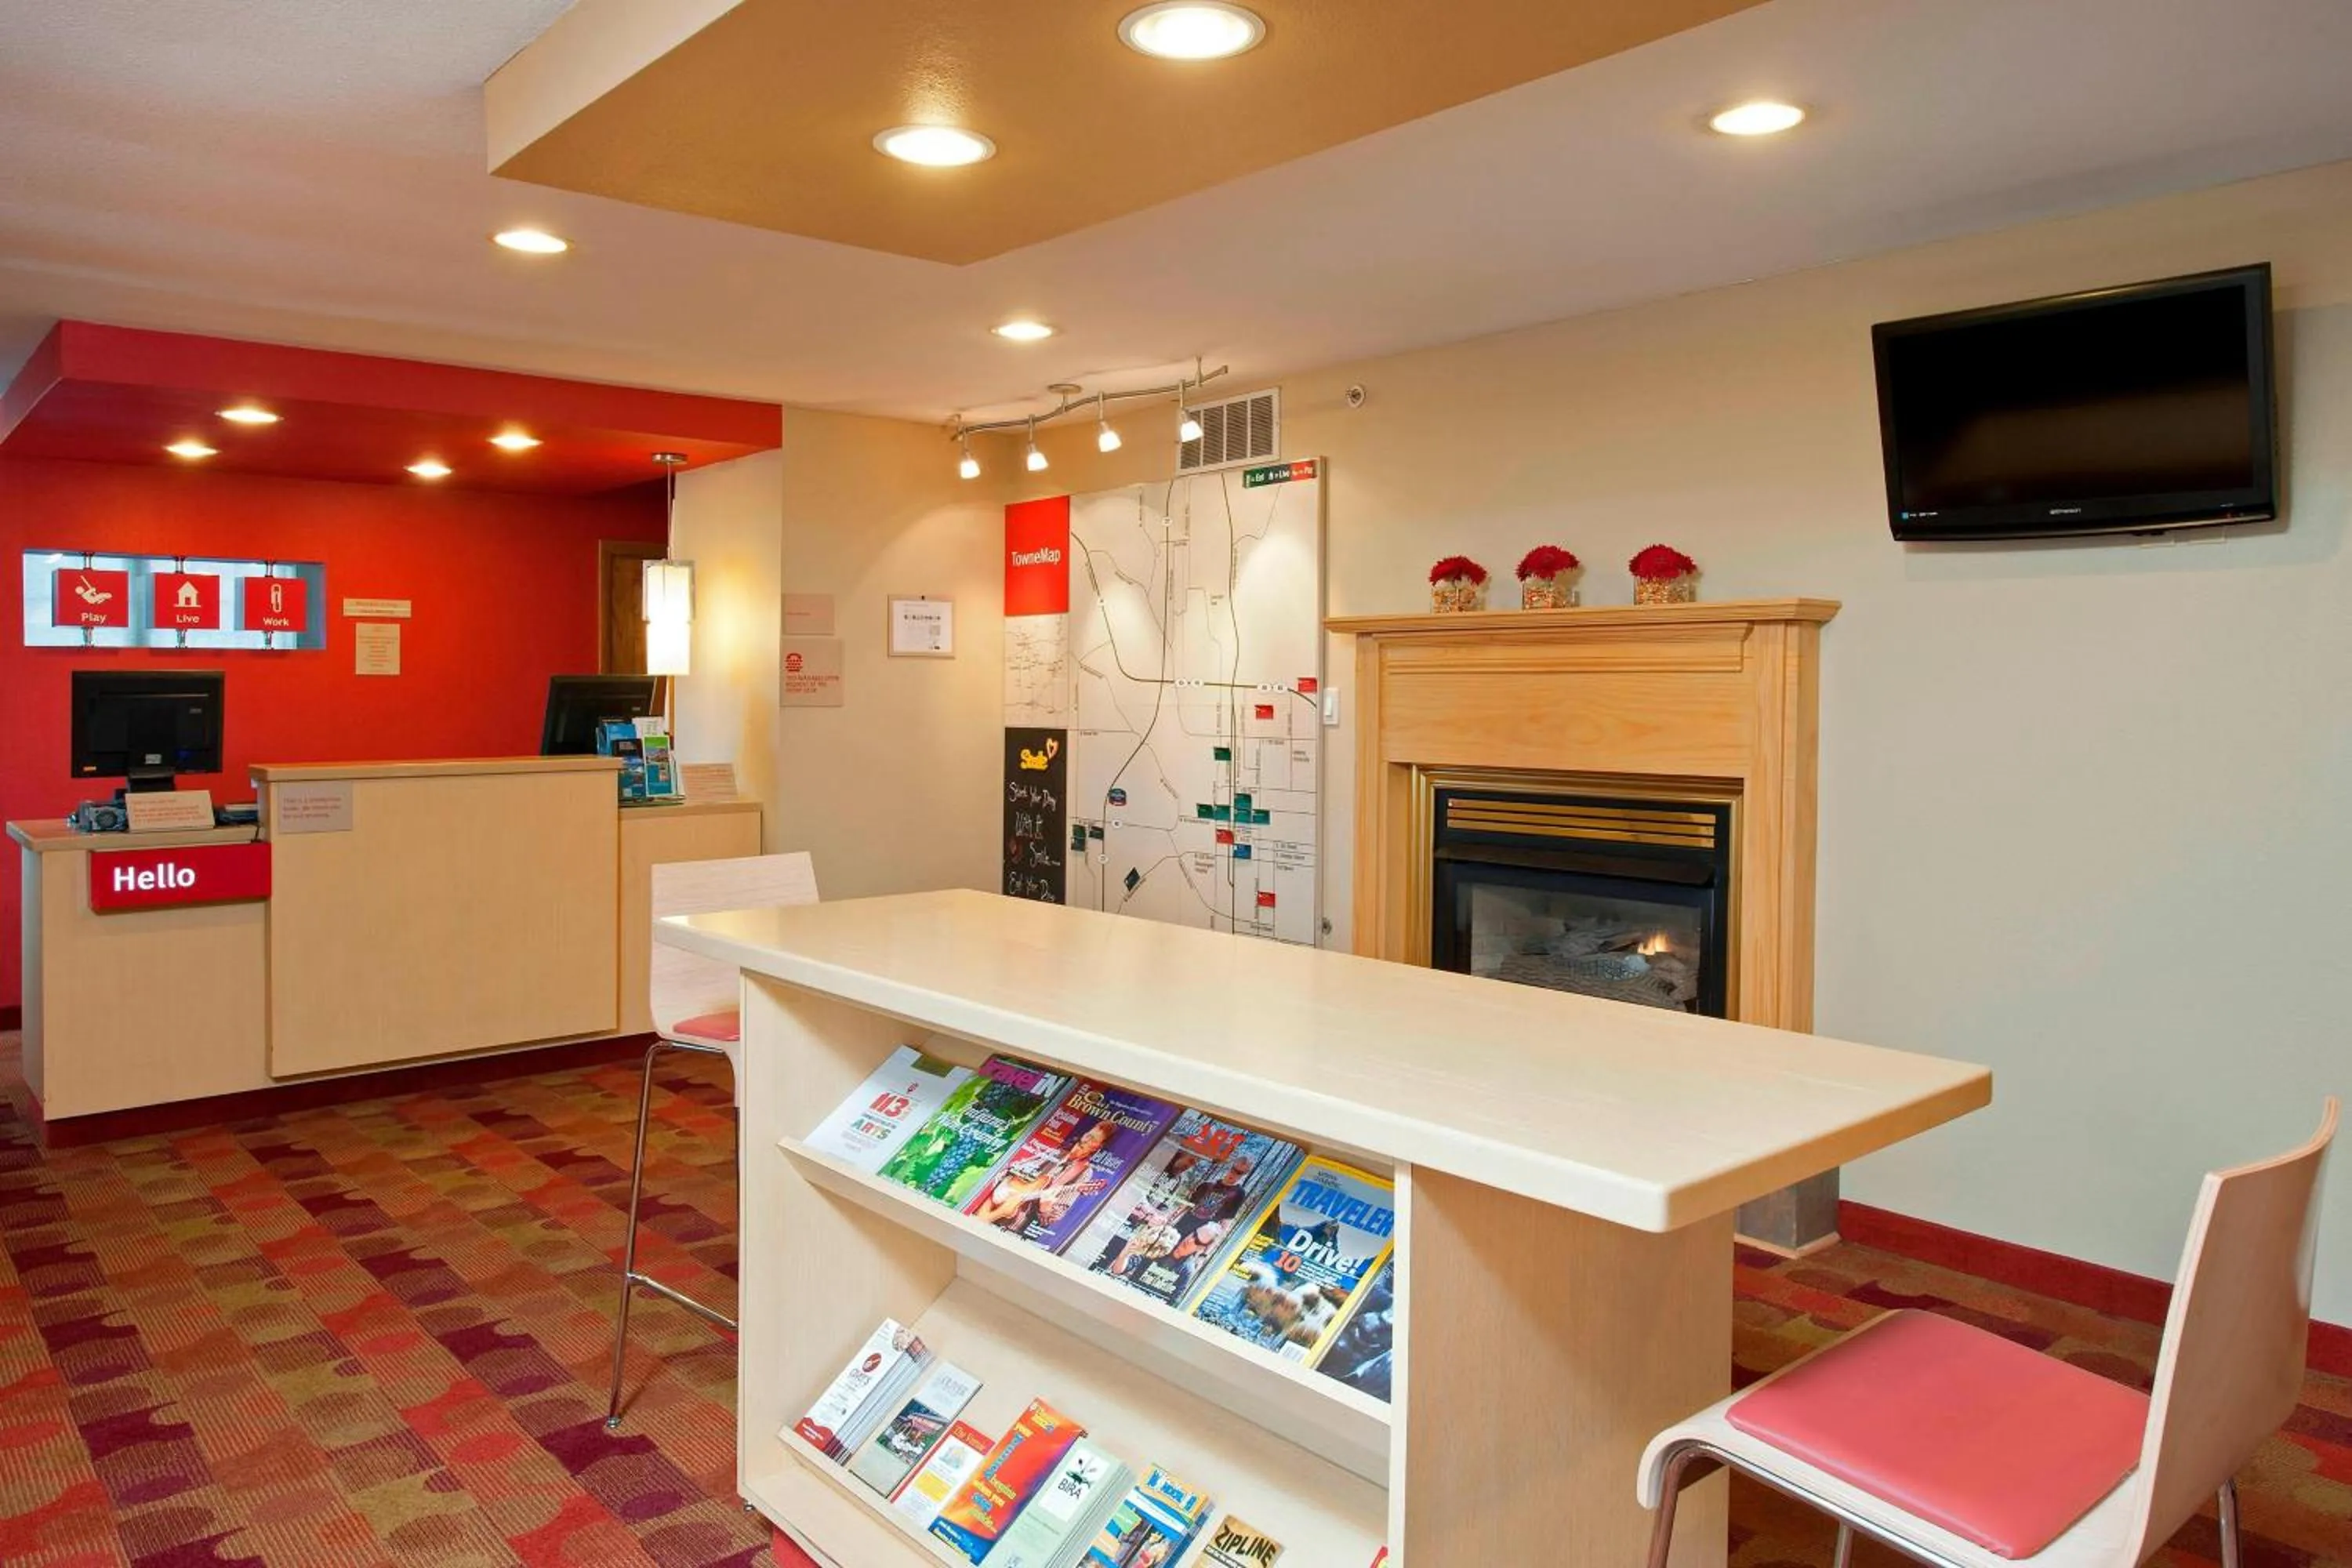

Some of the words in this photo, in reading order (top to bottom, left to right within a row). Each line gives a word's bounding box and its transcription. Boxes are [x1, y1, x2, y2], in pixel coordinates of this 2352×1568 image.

[1011, 547, 1061, 565] TowneMap
[81, 612, 107, 623] Play
[176, 614, 200, 623] Live
[263, 616, 289, 626] Work
[114, 862, 195, 891] Hello
[1066, 1094, 1111, 1120] Brown
[1111, 1109, 1158, 1136] County
[850, 1119, 891, 1140] ARTS
[1274, 1250, 1302, 1272] 10
[1285, 1229, 1363, 1275] Drive!
[1214, 1523, 1276, 1568] ZIPLINE
